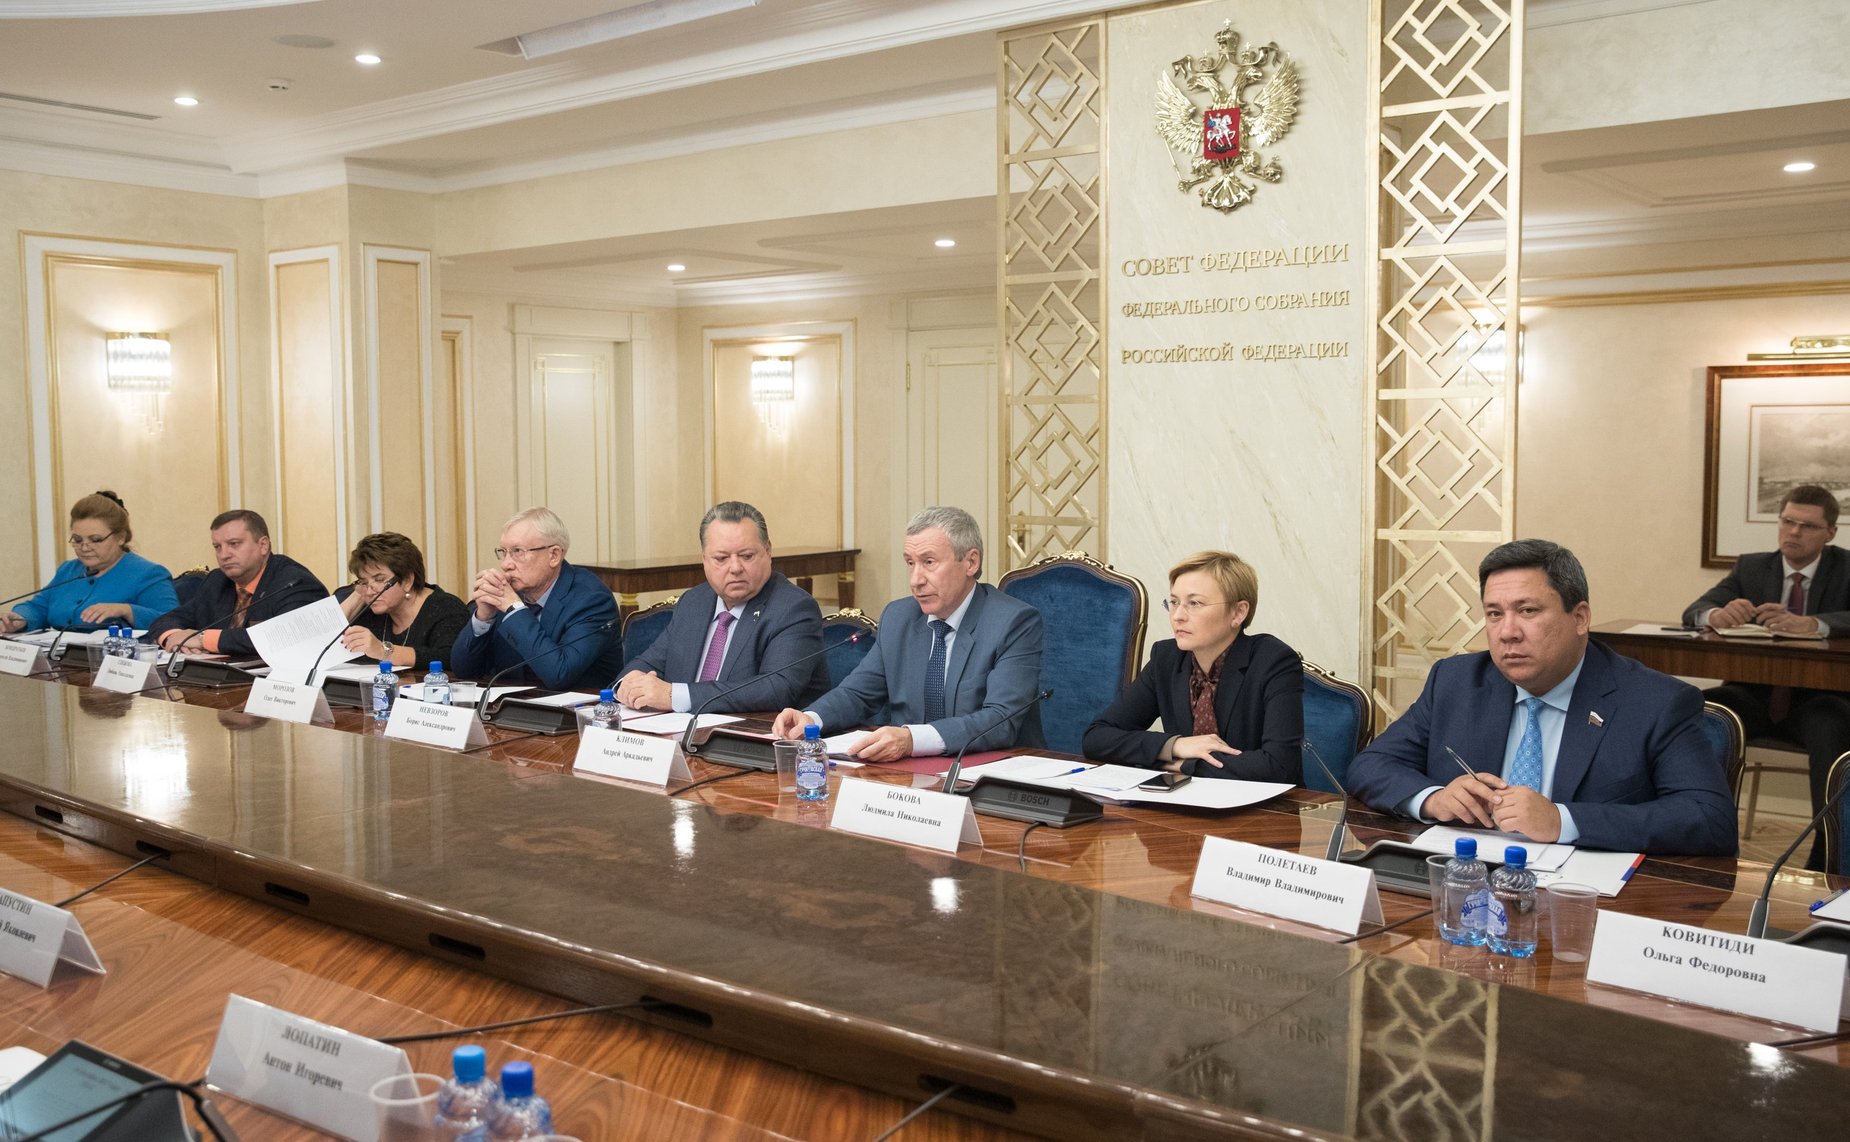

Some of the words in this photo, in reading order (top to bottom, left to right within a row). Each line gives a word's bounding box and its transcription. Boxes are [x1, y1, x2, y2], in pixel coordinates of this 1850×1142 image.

[1121, 255, 1194, 277] СОВЕТ
[1199, 243, 1350, 272] ФЕДЕРАЦИИ
[1121, 296, 1250, 318] ФЕДЕРАЛЬНОГО
[1254, 290, 1350, 311] СОБРАНИЯ
[1121, 342, 1234, 365] РОССИЙСКОЙ
[1241, 341, 1349, 362] ФЕДЕРАЦИИ
[419, 706, 449, 717] НЕВЗОРОВ
[406, 717, 420, 727] Борис
[421, 718, 456, 733] Александрович
[616, 735, 645, 746] КЛИМОВ
[602, 747, 621, 758] Андрей
[623, 751, 653, 763] Аркадьевич
[887, 791, 921, 805] БОКОВА
[1020, 794, 1050, 806] BOSCH
[861, 803, 895, 818] Людмила
[896, 810, 941, 827] Николаевна
[1258, 853, 1317, 876] ПОЛЕТАЕВ
[1226, 866, 1271, 888] Владимир
[1274, 878, 1344, 904] Владимирович
[1662, 926, 1755, 955] КОВИТИДИ
[1643, 946, 1682, 966] Ольга
[1688, 956, 1766, 984] Федоровна
[281, 1024, 342, 1057] ЛОПАТИН
[262, 1051, 292, 1073] Антон
[295, 1061, 343, 1092] Игоревич
